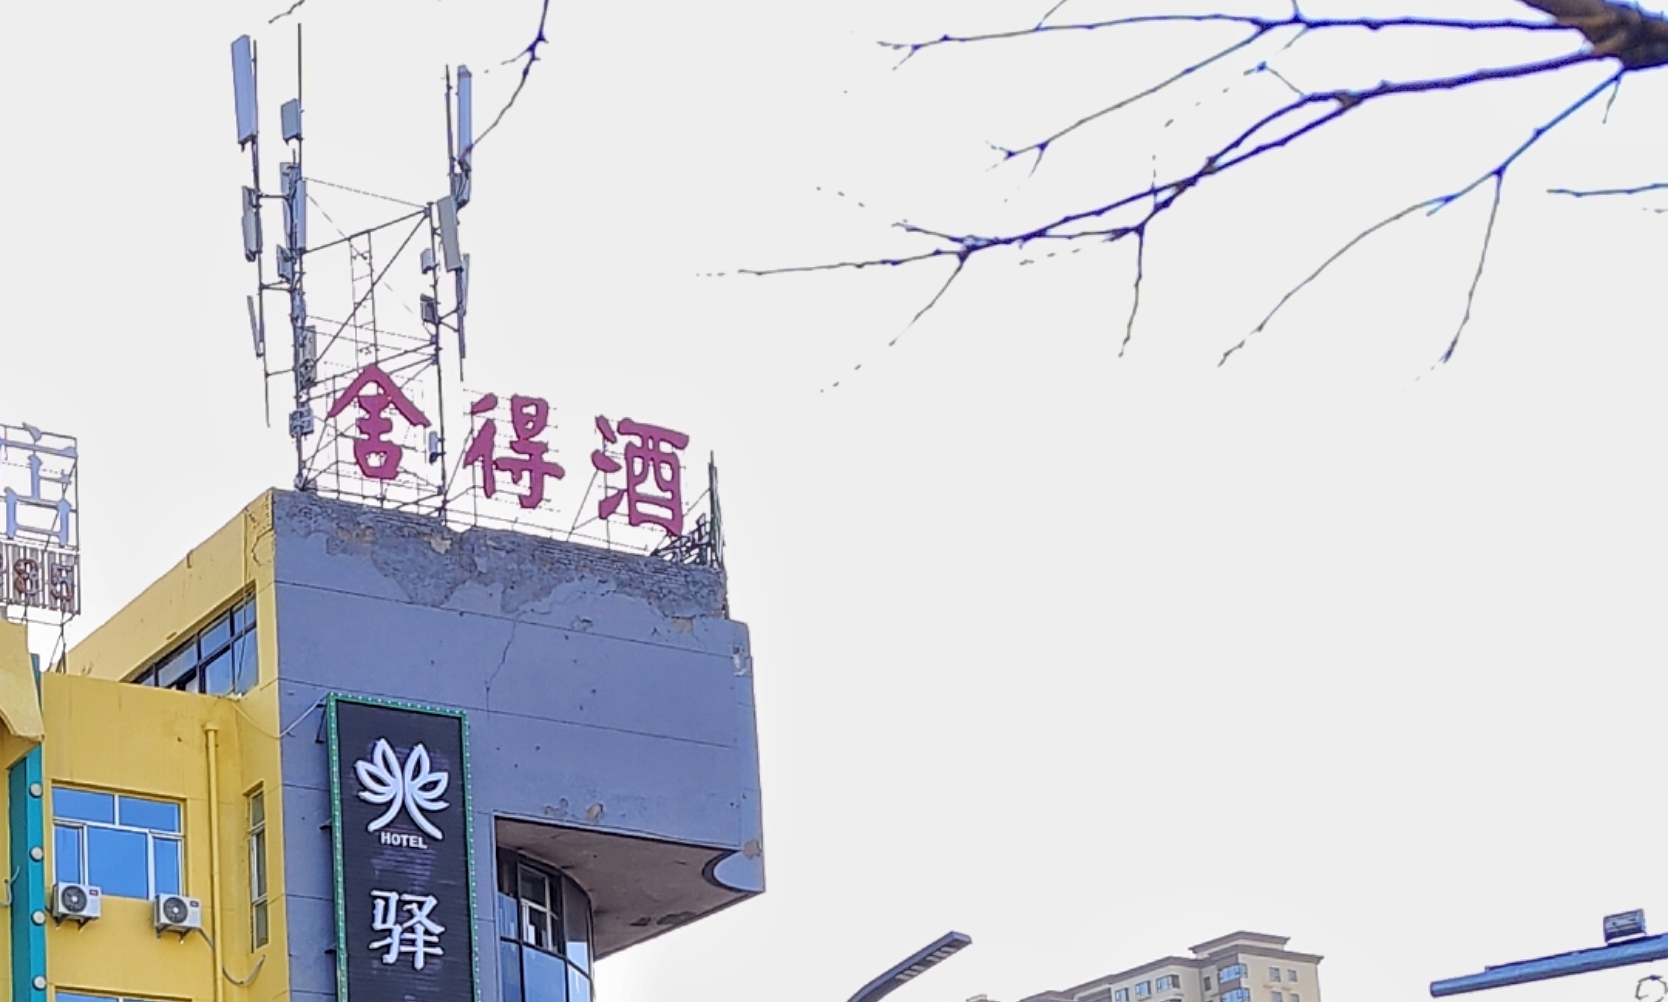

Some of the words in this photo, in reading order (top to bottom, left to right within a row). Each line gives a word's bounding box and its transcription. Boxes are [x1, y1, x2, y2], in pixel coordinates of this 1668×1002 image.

[327, 364, 690, 536] 舍得酒
[380, 831, 428, 849] HOTEL
